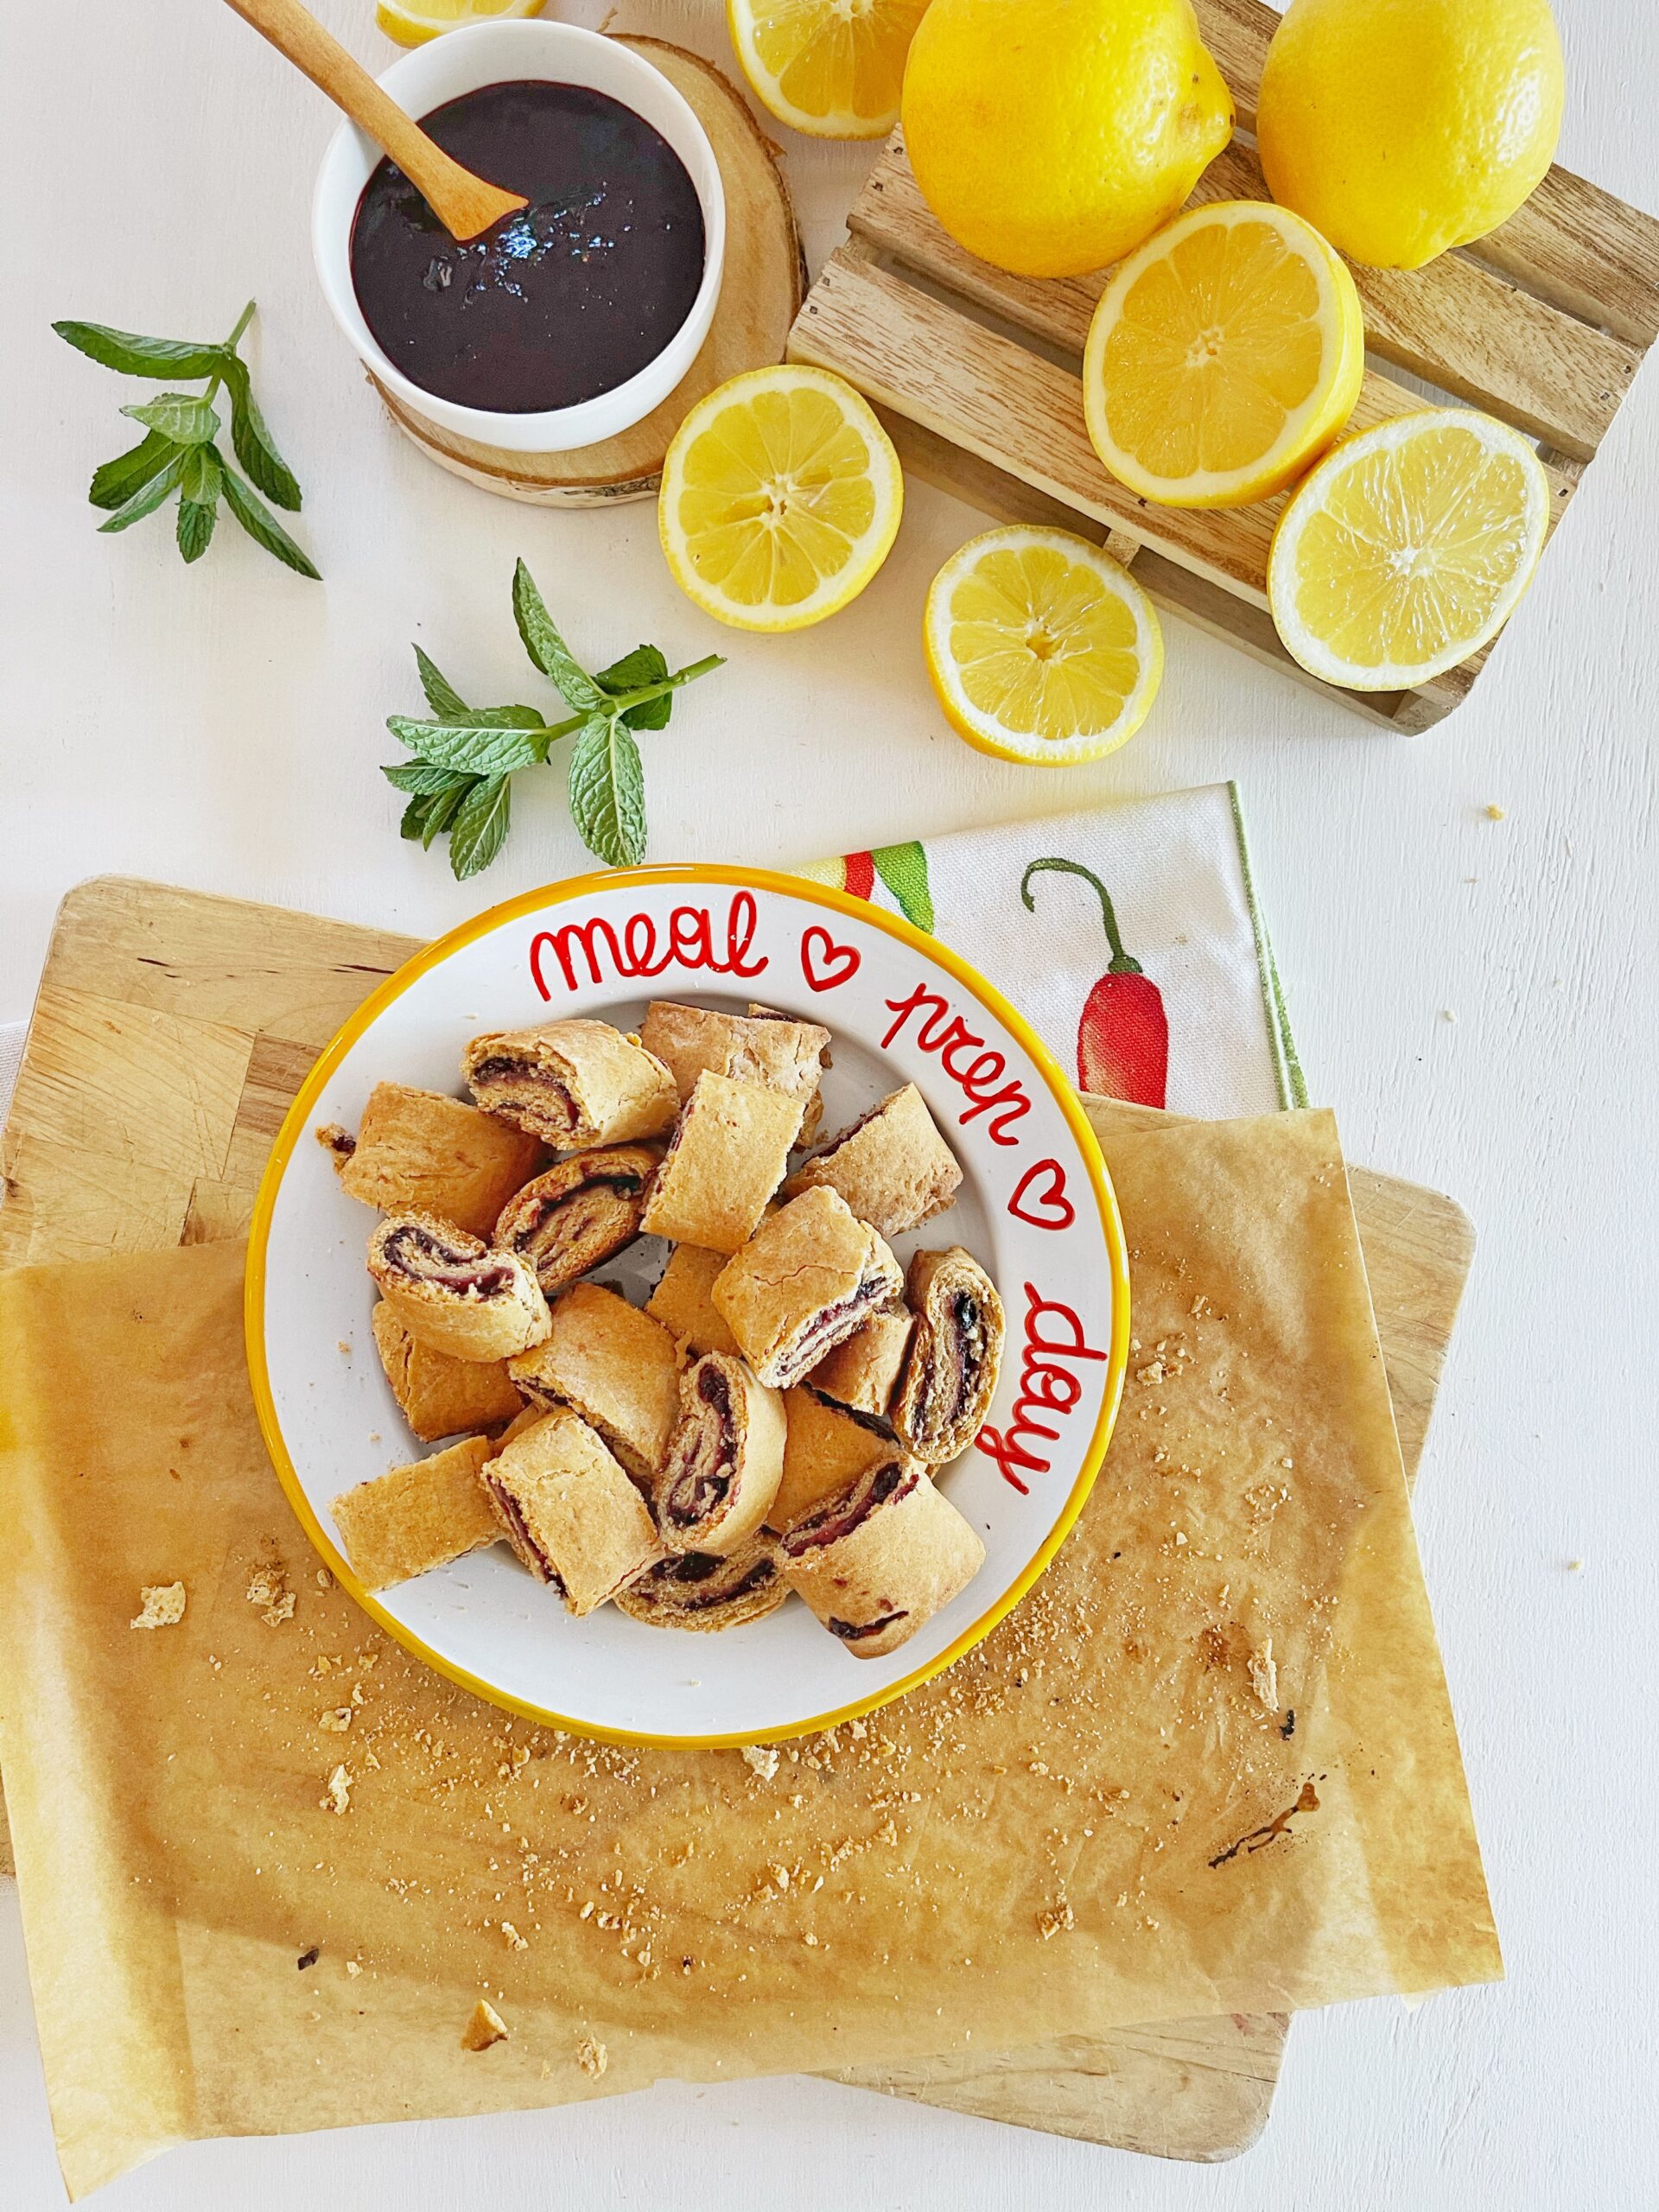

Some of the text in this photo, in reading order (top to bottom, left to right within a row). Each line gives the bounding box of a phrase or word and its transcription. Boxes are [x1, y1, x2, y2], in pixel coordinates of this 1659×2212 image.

[530, 891, 1108, 1496] meal prep day
